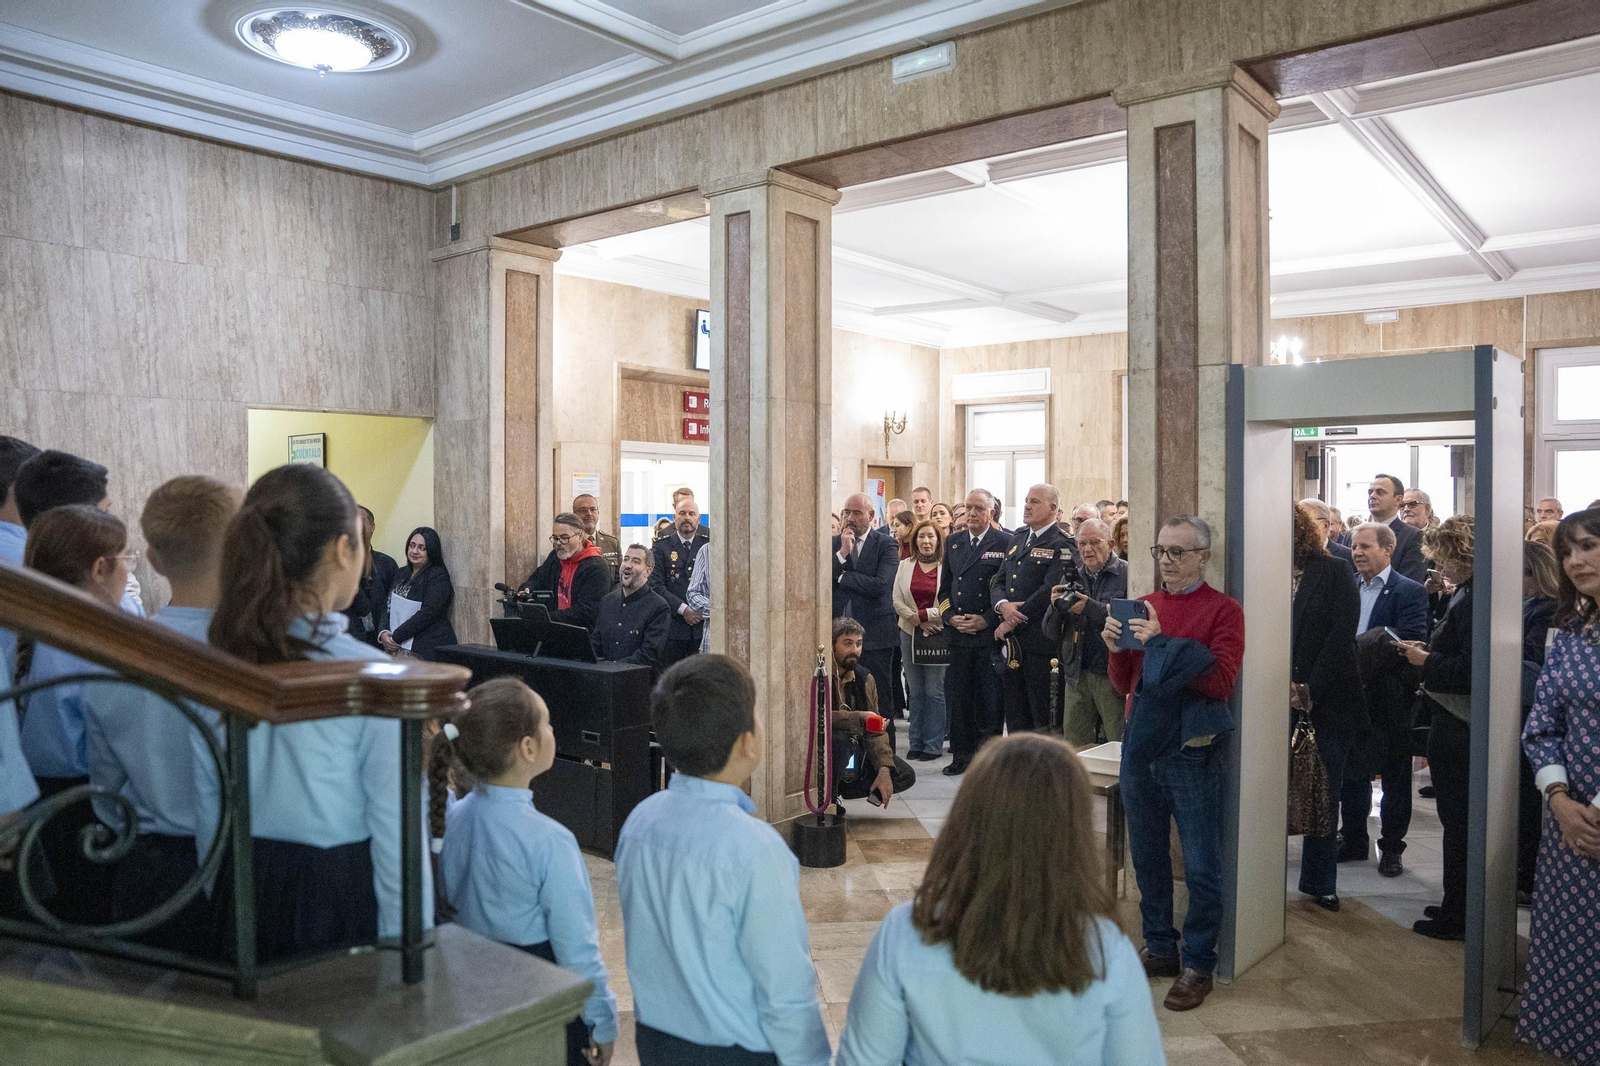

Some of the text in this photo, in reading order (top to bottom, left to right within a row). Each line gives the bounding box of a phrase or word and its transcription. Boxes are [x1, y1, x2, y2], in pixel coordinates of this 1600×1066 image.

[703, 398, 710, 409] R
[699, 424, 710, 435] Inf
[295, 446, 321, 459] CUÉNTALO
